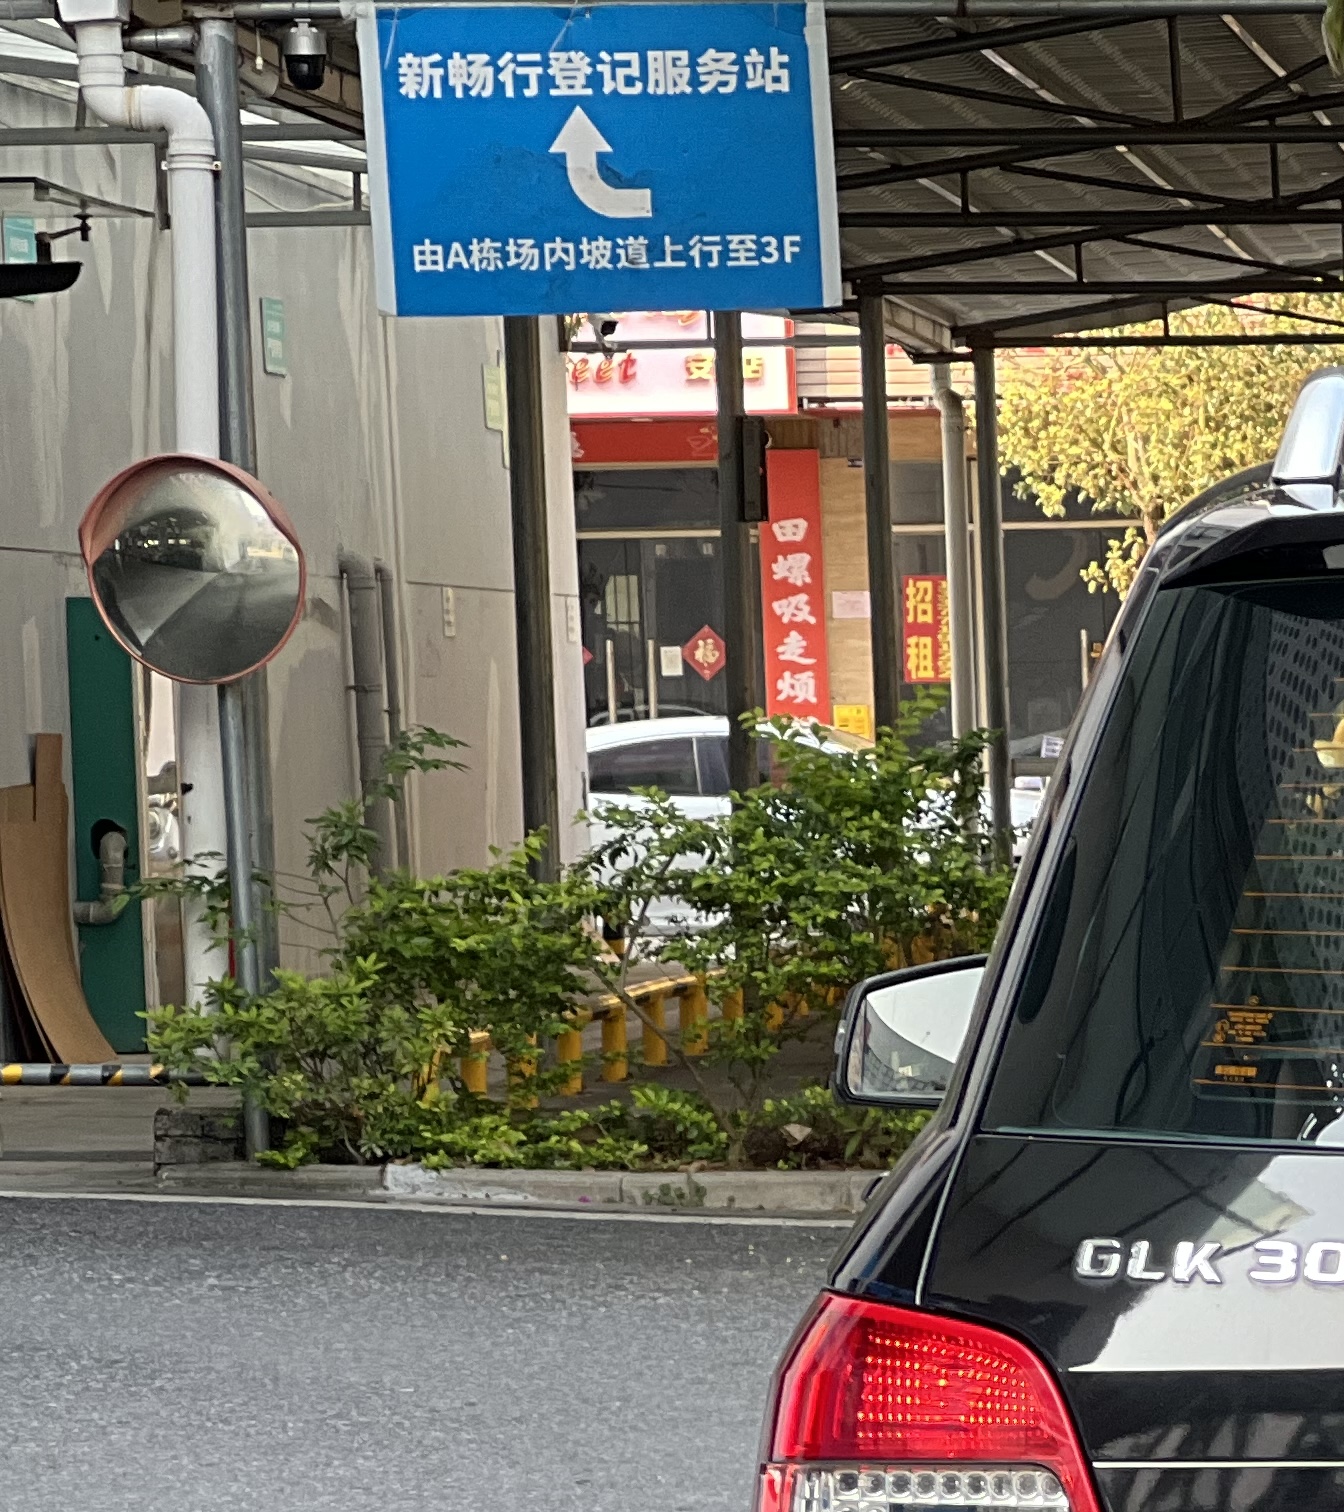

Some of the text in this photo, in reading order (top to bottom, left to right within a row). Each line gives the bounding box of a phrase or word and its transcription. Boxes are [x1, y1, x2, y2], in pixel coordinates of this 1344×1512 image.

[397, 46, 791, 99] 新畅行登记服务站
[412, 233, 802, 273] 由A栋场内坡道上行至3F
[567, 352, 638, 385] eet
[771, 517, 820, 733] 田螺吸走烦
[906, 577, 935, 680] 招租
[1075, 1237, 1224, 1285] GLK
